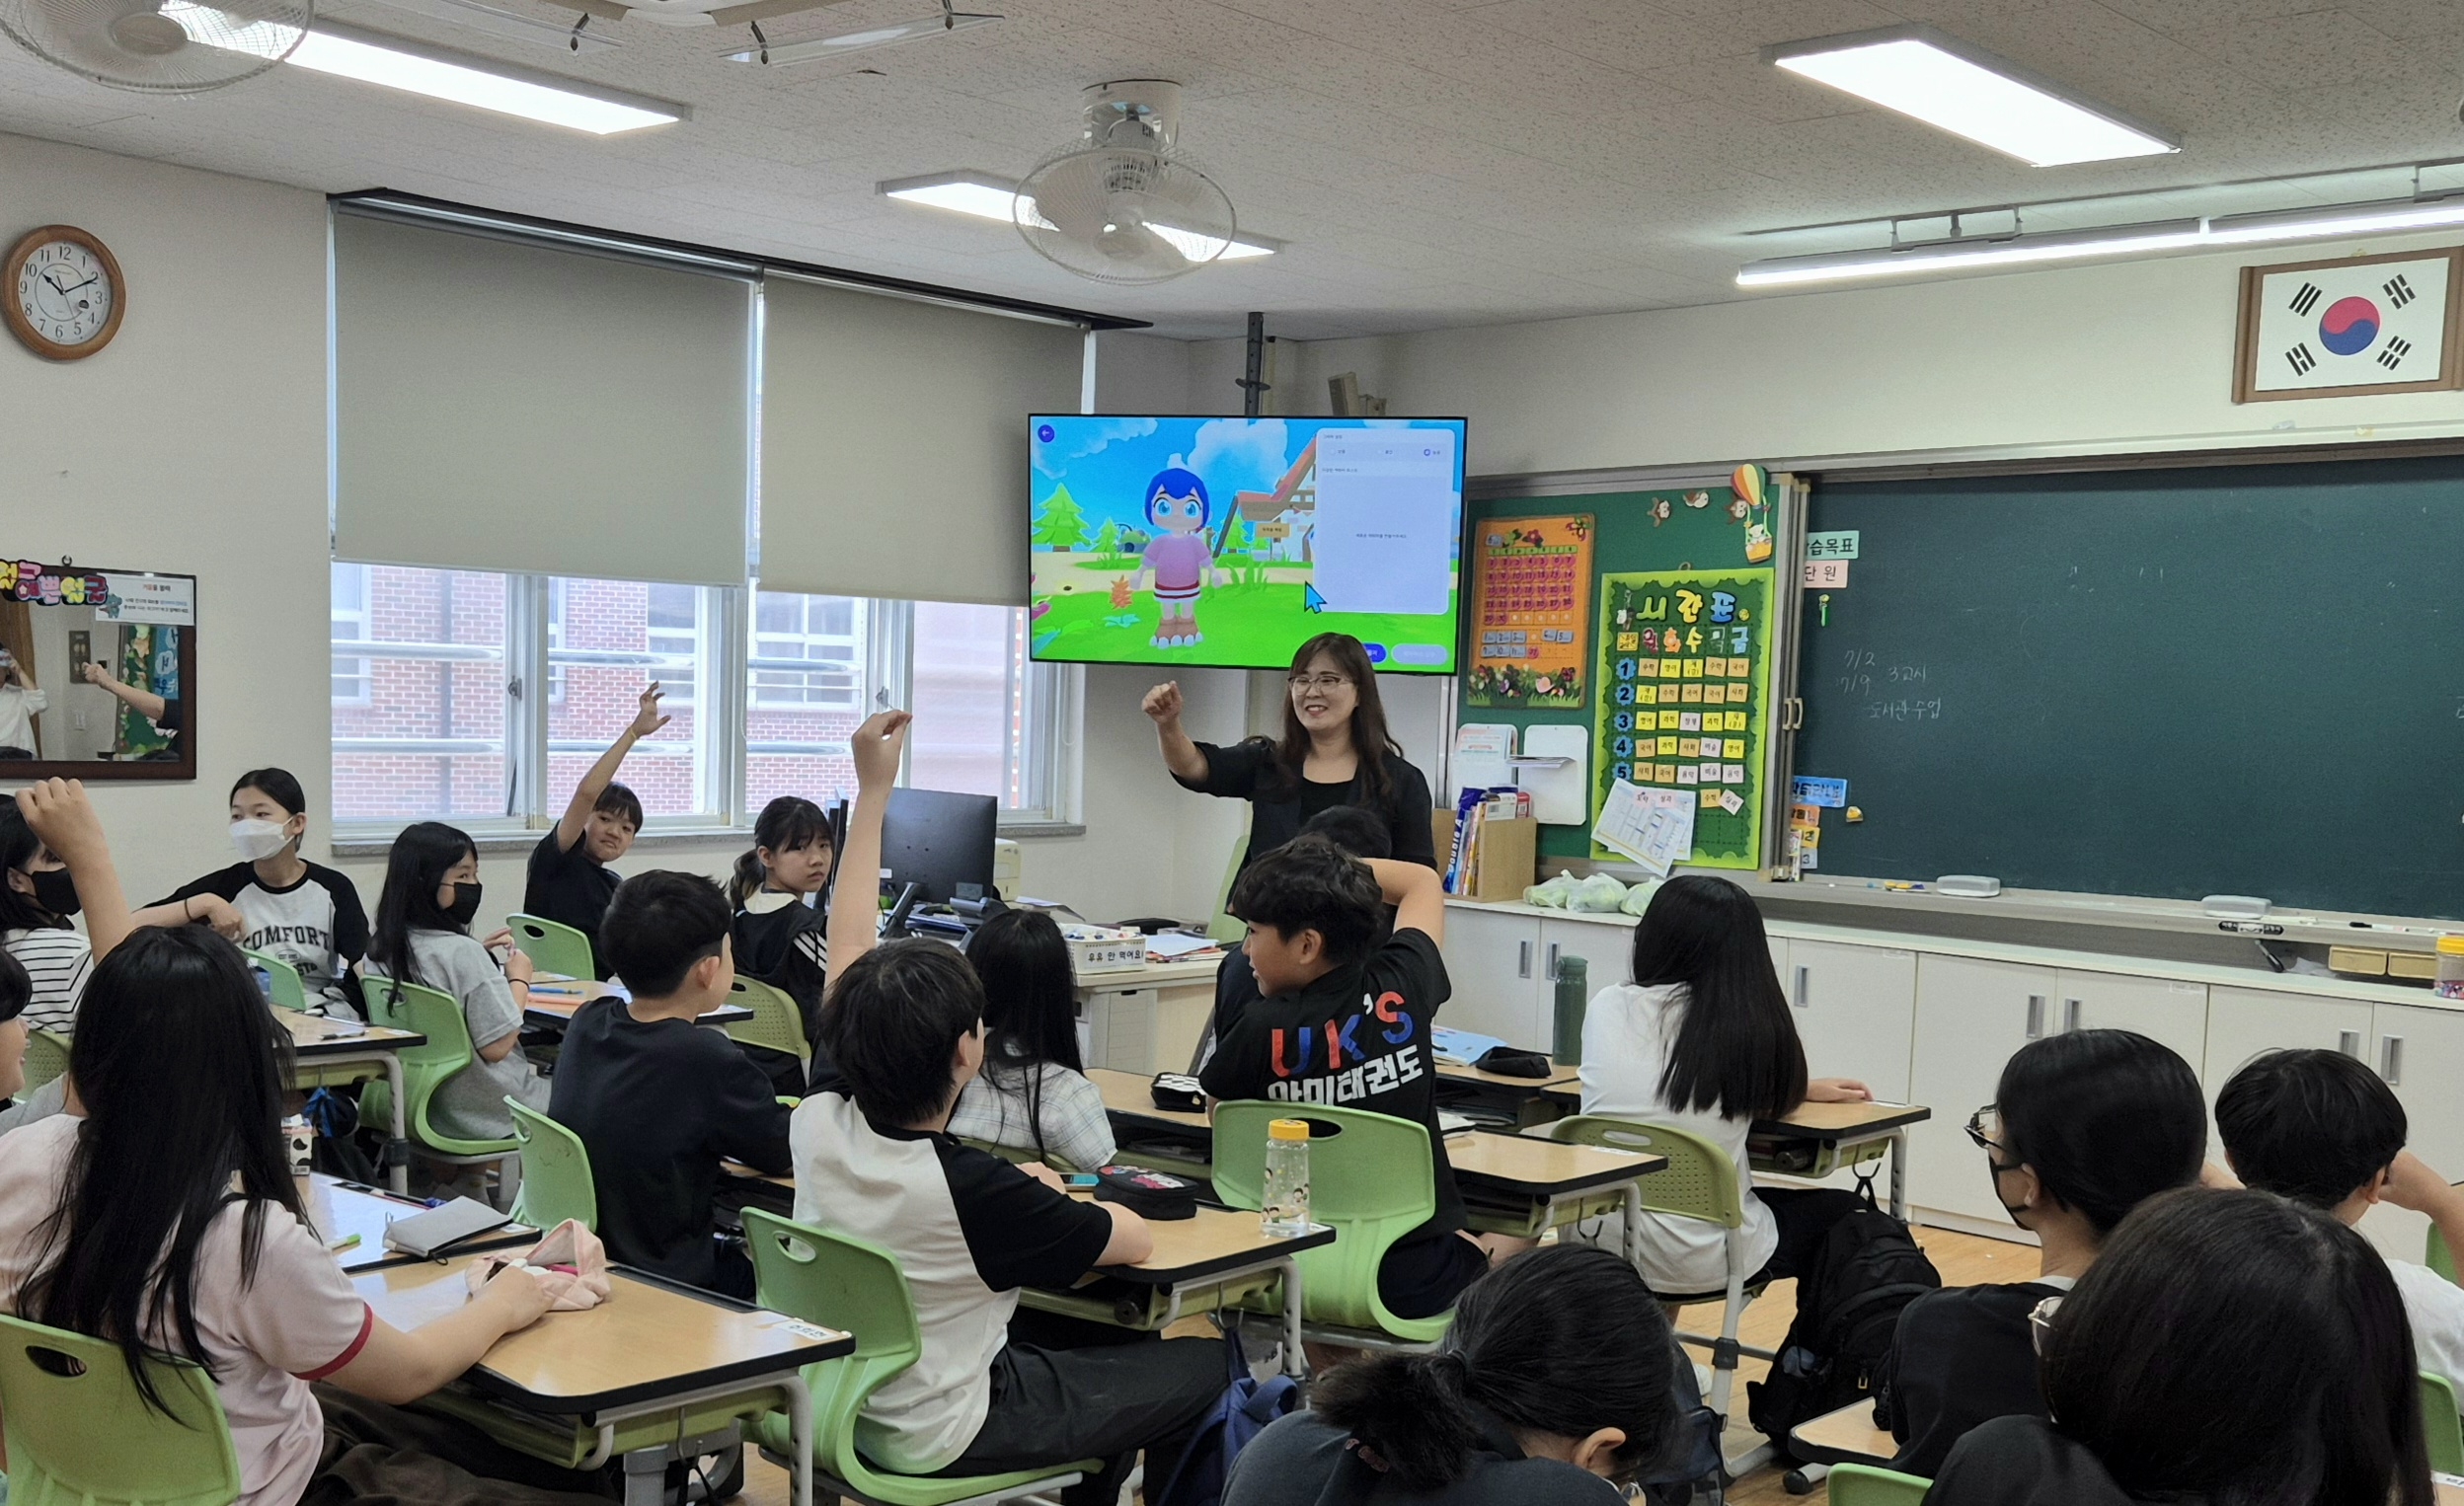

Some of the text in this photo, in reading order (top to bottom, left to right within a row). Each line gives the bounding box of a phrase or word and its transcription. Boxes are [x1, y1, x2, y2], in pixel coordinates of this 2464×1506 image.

[40, 250, 50, 263] 11
[59, 246, 71, 261] 12
[82, 256, 86, 268] 1
[25, 263, 38, 277] 10
[20, 280, 28, 294] 9
[95, 291, 103, 305] 3
[25, 303, 33, 316] 8
[88, 312, 95, 324] 4
[39, 319, 45, 332] 7
[55, 325, 63, 339] 6
[74, 322, 82, 336] 5
[1807, 538, 1854, 556] 습목표
[1686, 626, 1703, 653] 수
[1732, 627, 1749, 653] 금
[1844, 648, 1875, 670] 7/2
[1620, 662, 1628, 676] 1
[1888, 664, 1926, 683] 3교시
[1841, 673, 1871, 697] 7/9
[1620, 687, 1630, 700] 2
[1911, 697, 1941, 720] 수업
[1619, 715, 1628, 728] 3
[1617, 739, 1626, 753] 4
[1617, 766, 1627, 779] 5
[1455, 818, 1463, 827] A
[1803, 854, 1810, 865] 3
[243, 926, 329, 950] COMFORT
[1088, 952, 1104, 962] 우유
[1108, 951, 1116, 961] 안
[1271, 991, 1414, 1078] UK'S
[1268, 1044, 1424, 1105] 아미태권도
